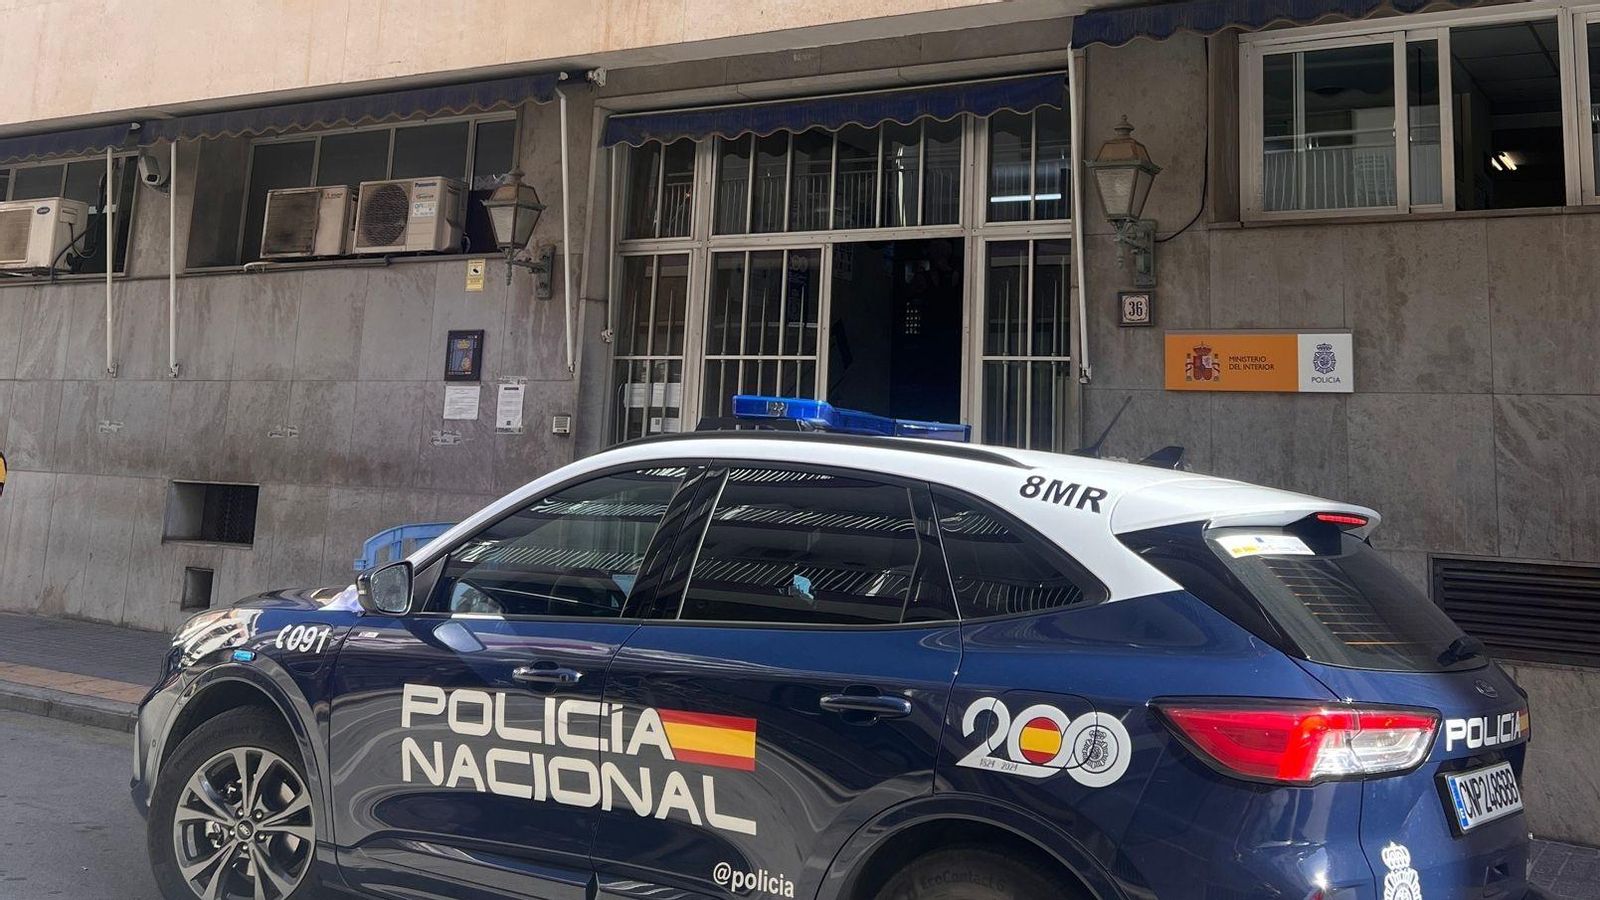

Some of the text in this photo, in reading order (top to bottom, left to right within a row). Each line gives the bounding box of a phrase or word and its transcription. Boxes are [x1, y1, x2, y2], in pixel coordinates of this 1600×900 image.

[1128, 300, 1143, 317] 36
[1228, 355, 1267, 363] MINISTERIO
[1228, 363, 1275, 371] DEL INTERIOR
[1019, 475, 1108, 514] 8MR
[286, 625, 331, 654] 091
[955, 696, 1132, 788] 200
[401, 737, 757, 836] NACIONAL
[713, 861, 794, 898] @policia
